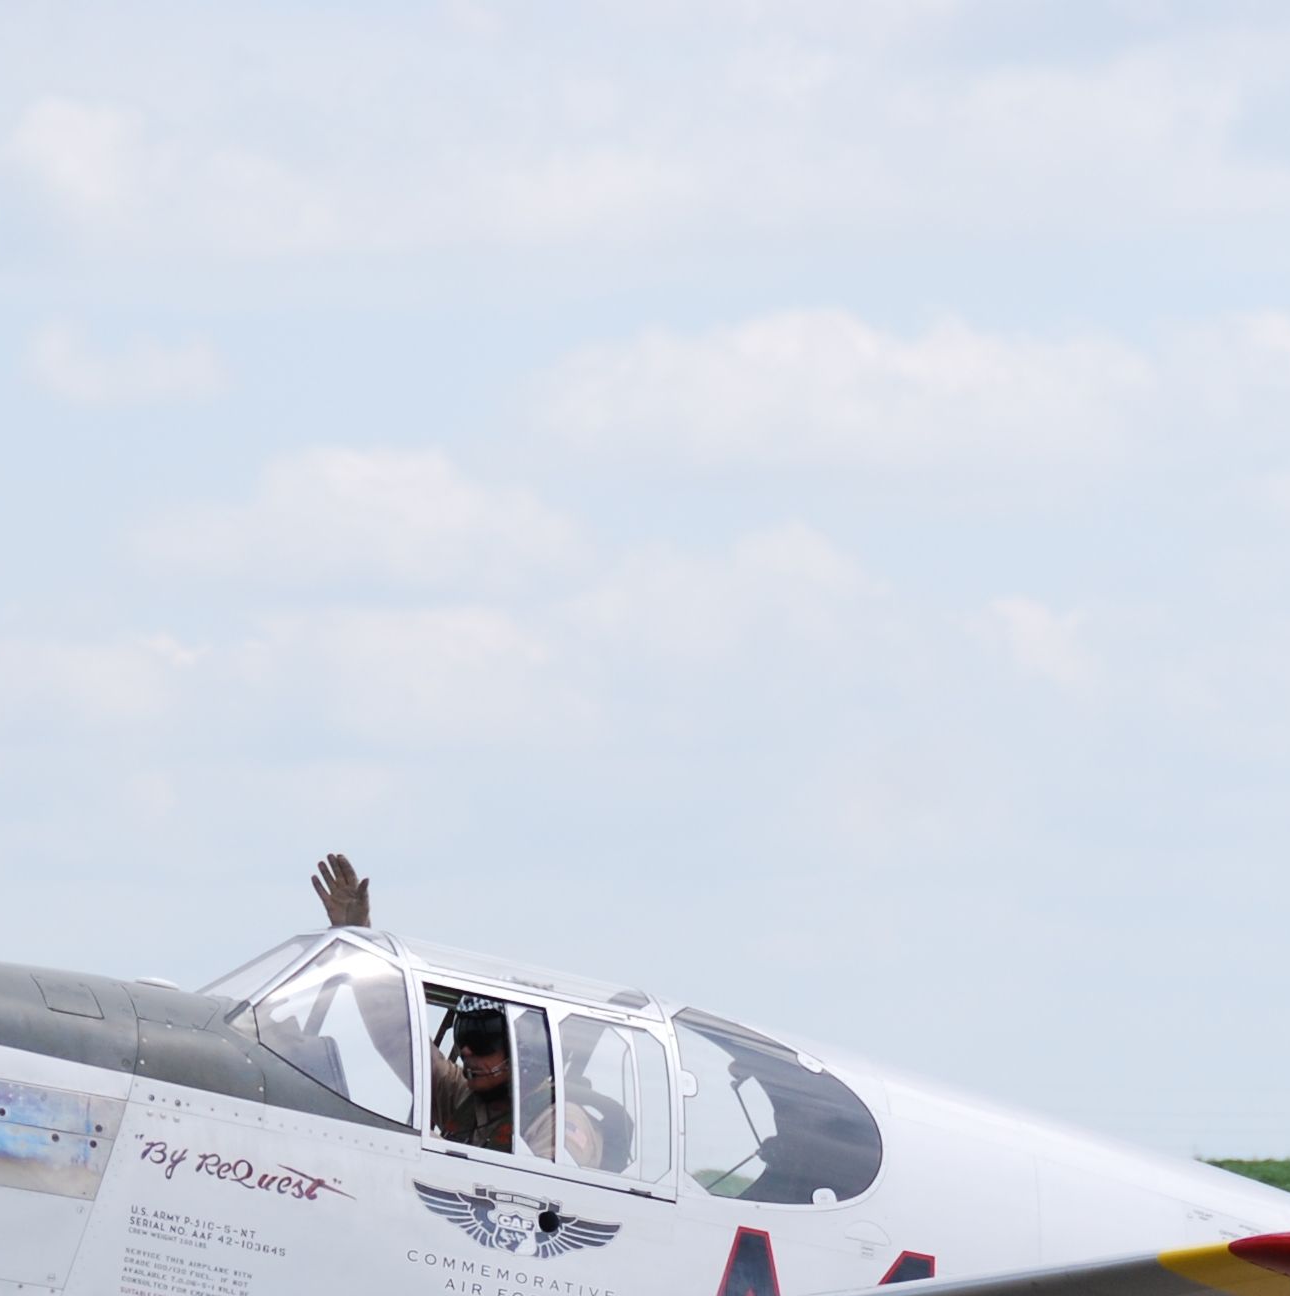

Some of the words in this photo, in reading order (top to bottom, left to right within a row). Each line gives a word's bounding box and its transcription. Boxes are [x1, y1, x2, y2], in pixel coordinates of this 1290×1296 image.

[131, 1205, 149, 1217] U.S.
[153, 1210, 181, 1223] ARMY
[498, 1214, 534, 1231] CAF
[128, 1227, 148, 1237] CREW
[150, 1232, 177, 1243] WEIGHT
[194, 1241, 208, 1250] LBS
[129, 1216, 165, 1232] SERIAL
[170, 1225, 188, 1237] NO.
[192, 1230, 213, 1241] AAF
[217, 1235, 286, 1257] 42-103645
[123, 1256, 150, 1269] GRADE
[220, 1277, 229, 1285] IF
[232, 1279, 249, 1288] NOT
[125, 1247, 161, 1261] SERVICE
[165, 1255, 185, 1265] THIS
[188, 1261, 229, 1275] AIRPLANE
[233, 1270, 253, 1280] WITH
[121, 1275, 169, 1291] CONSULTED
[171, 1285, 187, 1294] FOR
[123, 1266, 168, 1281] AVAILABLE
[218, 1284, 236, 1296] WILL
[445, 1278, 482, 1296] AIR
